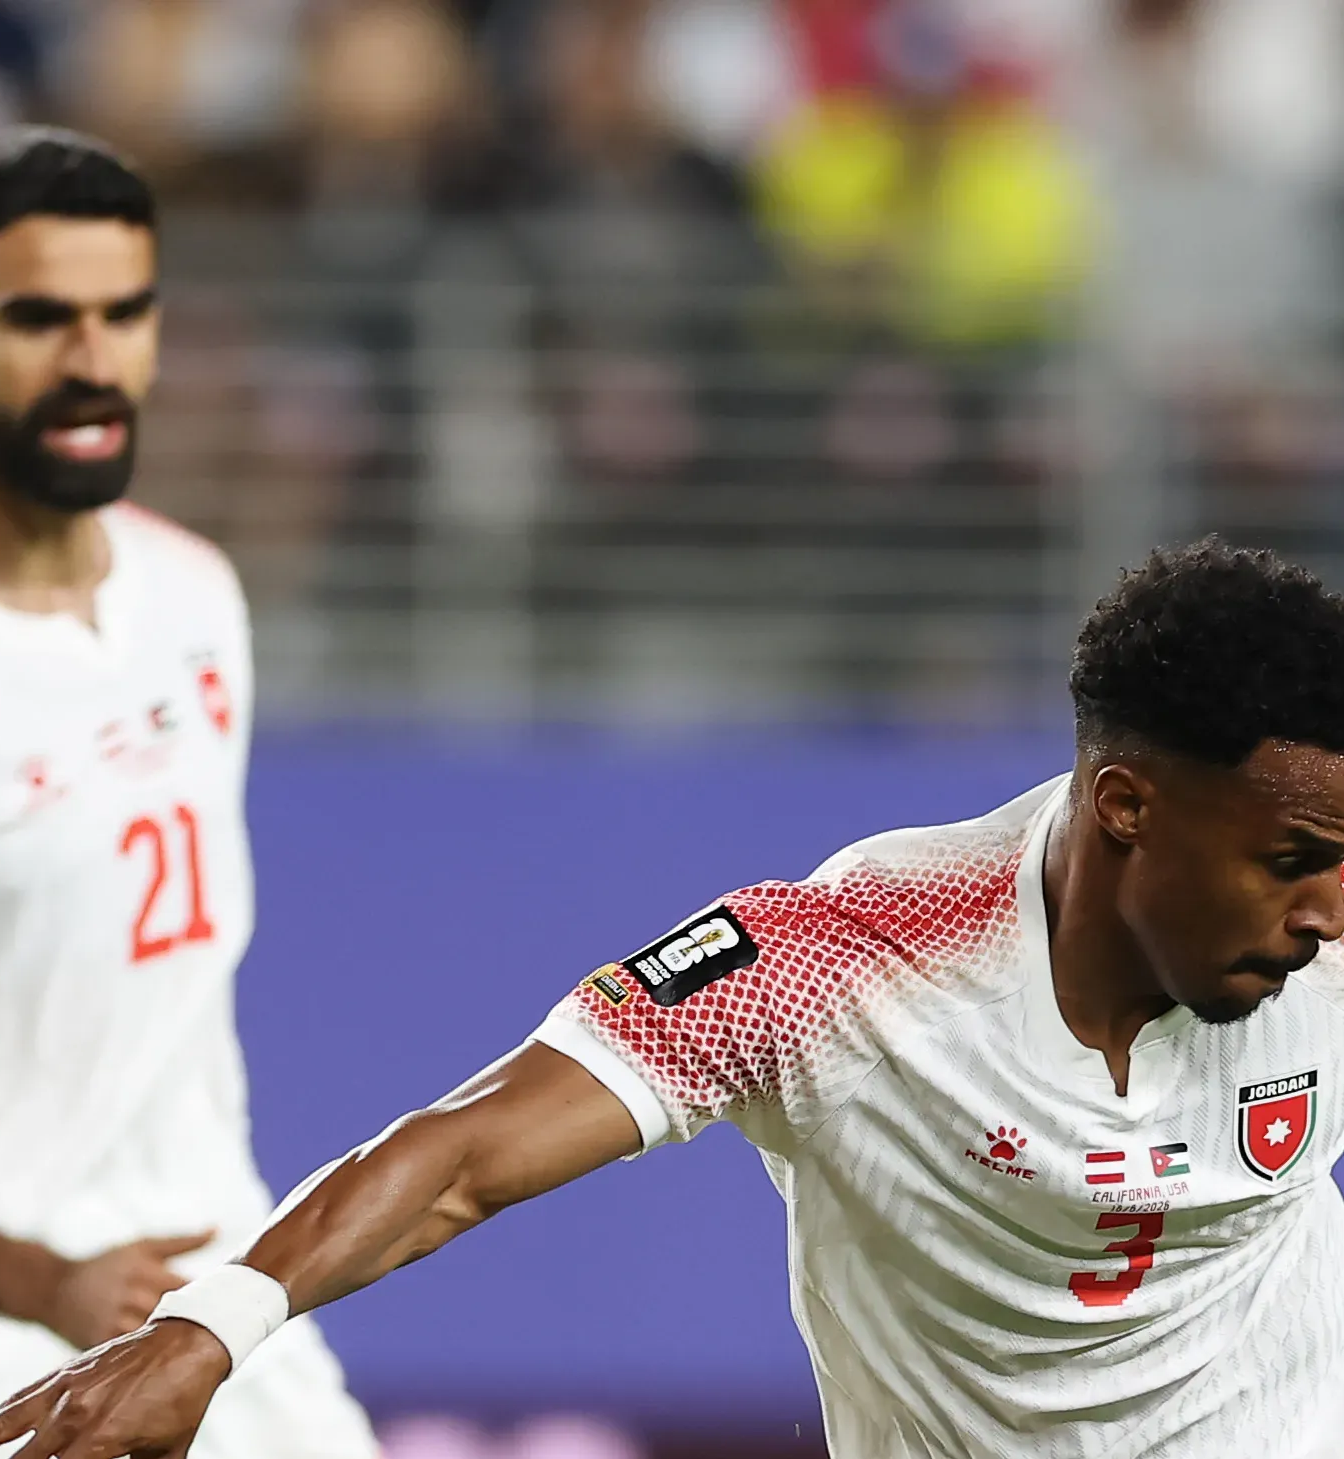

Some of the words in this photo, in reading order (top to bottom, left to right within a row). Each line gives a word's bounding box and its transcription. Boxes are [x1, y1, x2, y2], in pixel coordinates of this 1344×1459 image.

[117, 803, 215, 966] 21
[600, 975, 627, 997] DEBUT
[634, 959, 664, 986] 2026
[1247, 1074, 1310, 1101] JORDAN
[964, 1148, 1037, 1181] KELME
[1091, 1185, 1165, 1204] CALIFORNIA,
[1165, 1181, 1190, 1197] USA
[1067, 1212, 1165, 1307] 3
